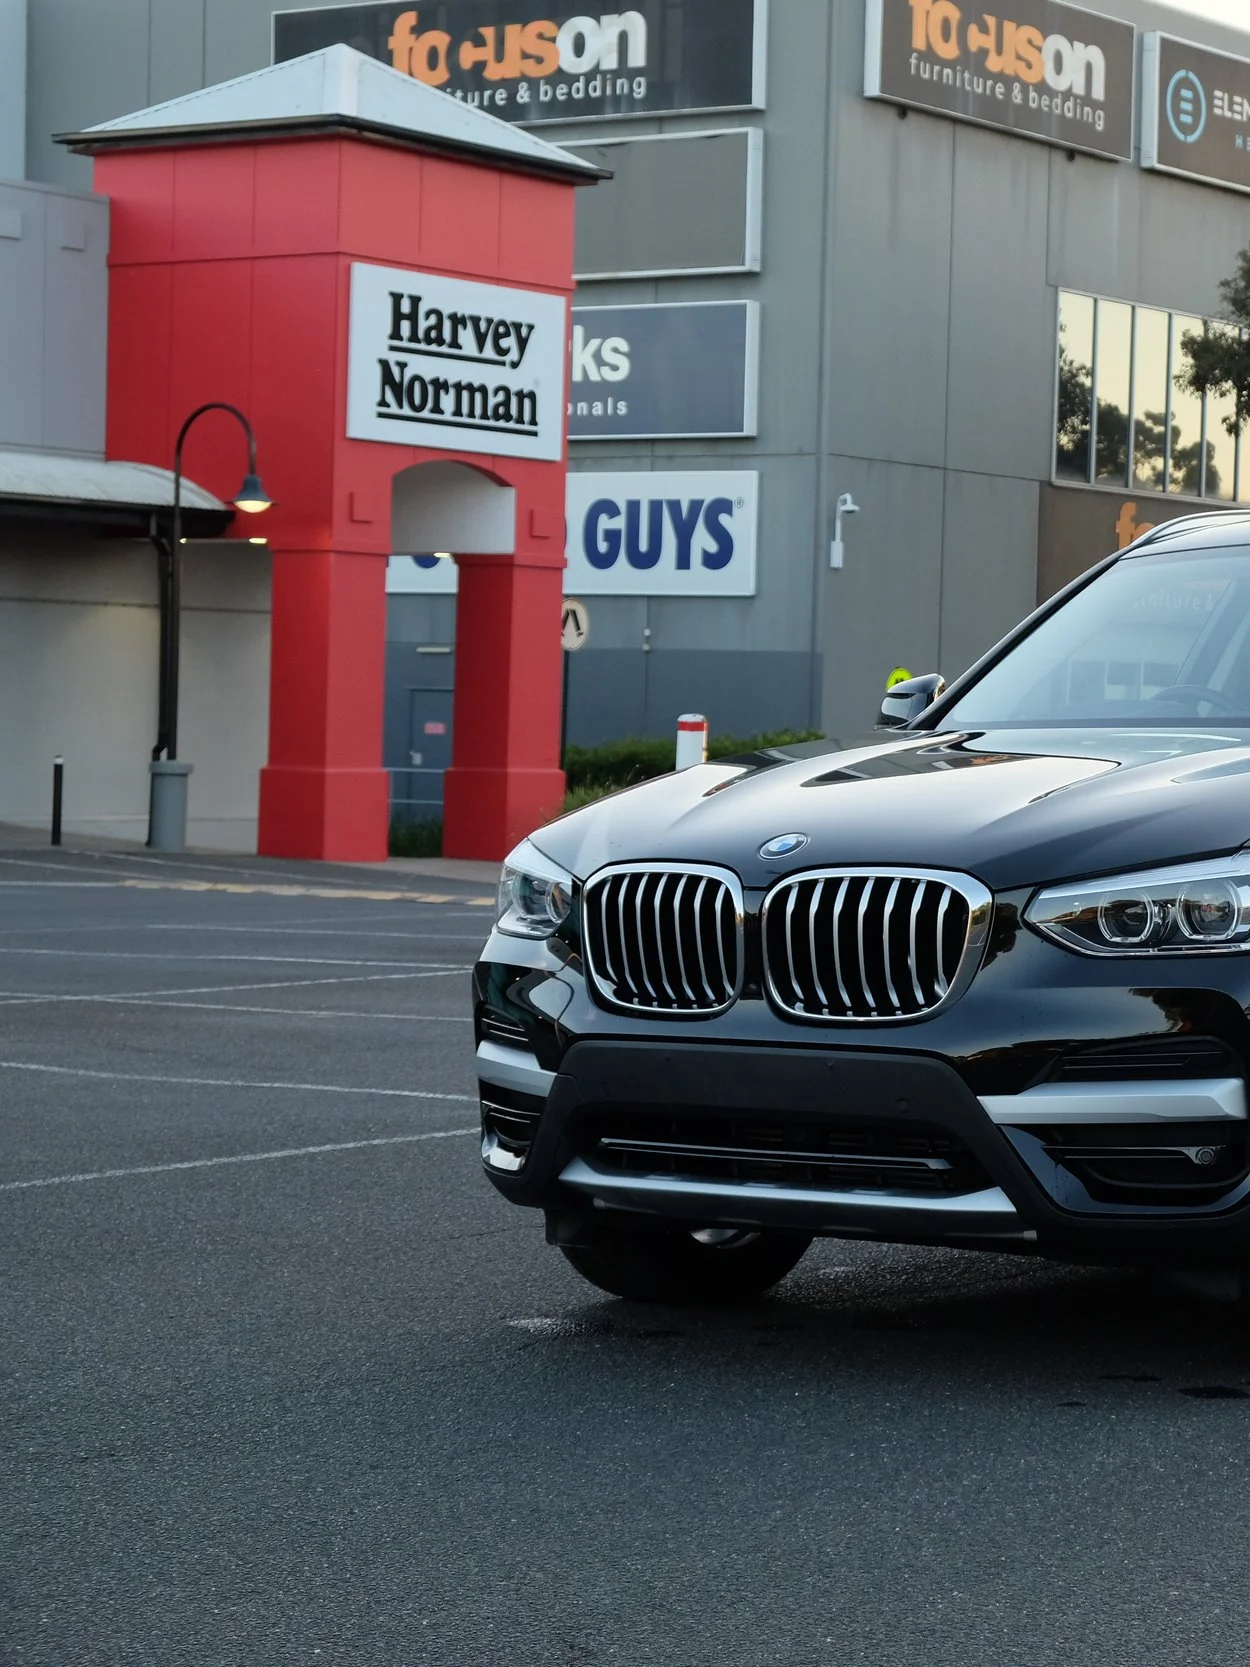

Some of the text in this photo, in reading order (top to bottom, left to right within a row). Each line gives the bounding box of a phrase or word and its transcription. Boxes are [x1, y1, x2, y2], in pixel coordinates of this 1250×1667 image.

[516, 82, 532, 104] &
[539, 75, 647, 100] bedding
[909, 52, 1105, 132] furniture & bedding
[388, 291, 535, 370] Harvey
[568, 324, 631, 382] ks
[376, 357, 539, 427] Norman
